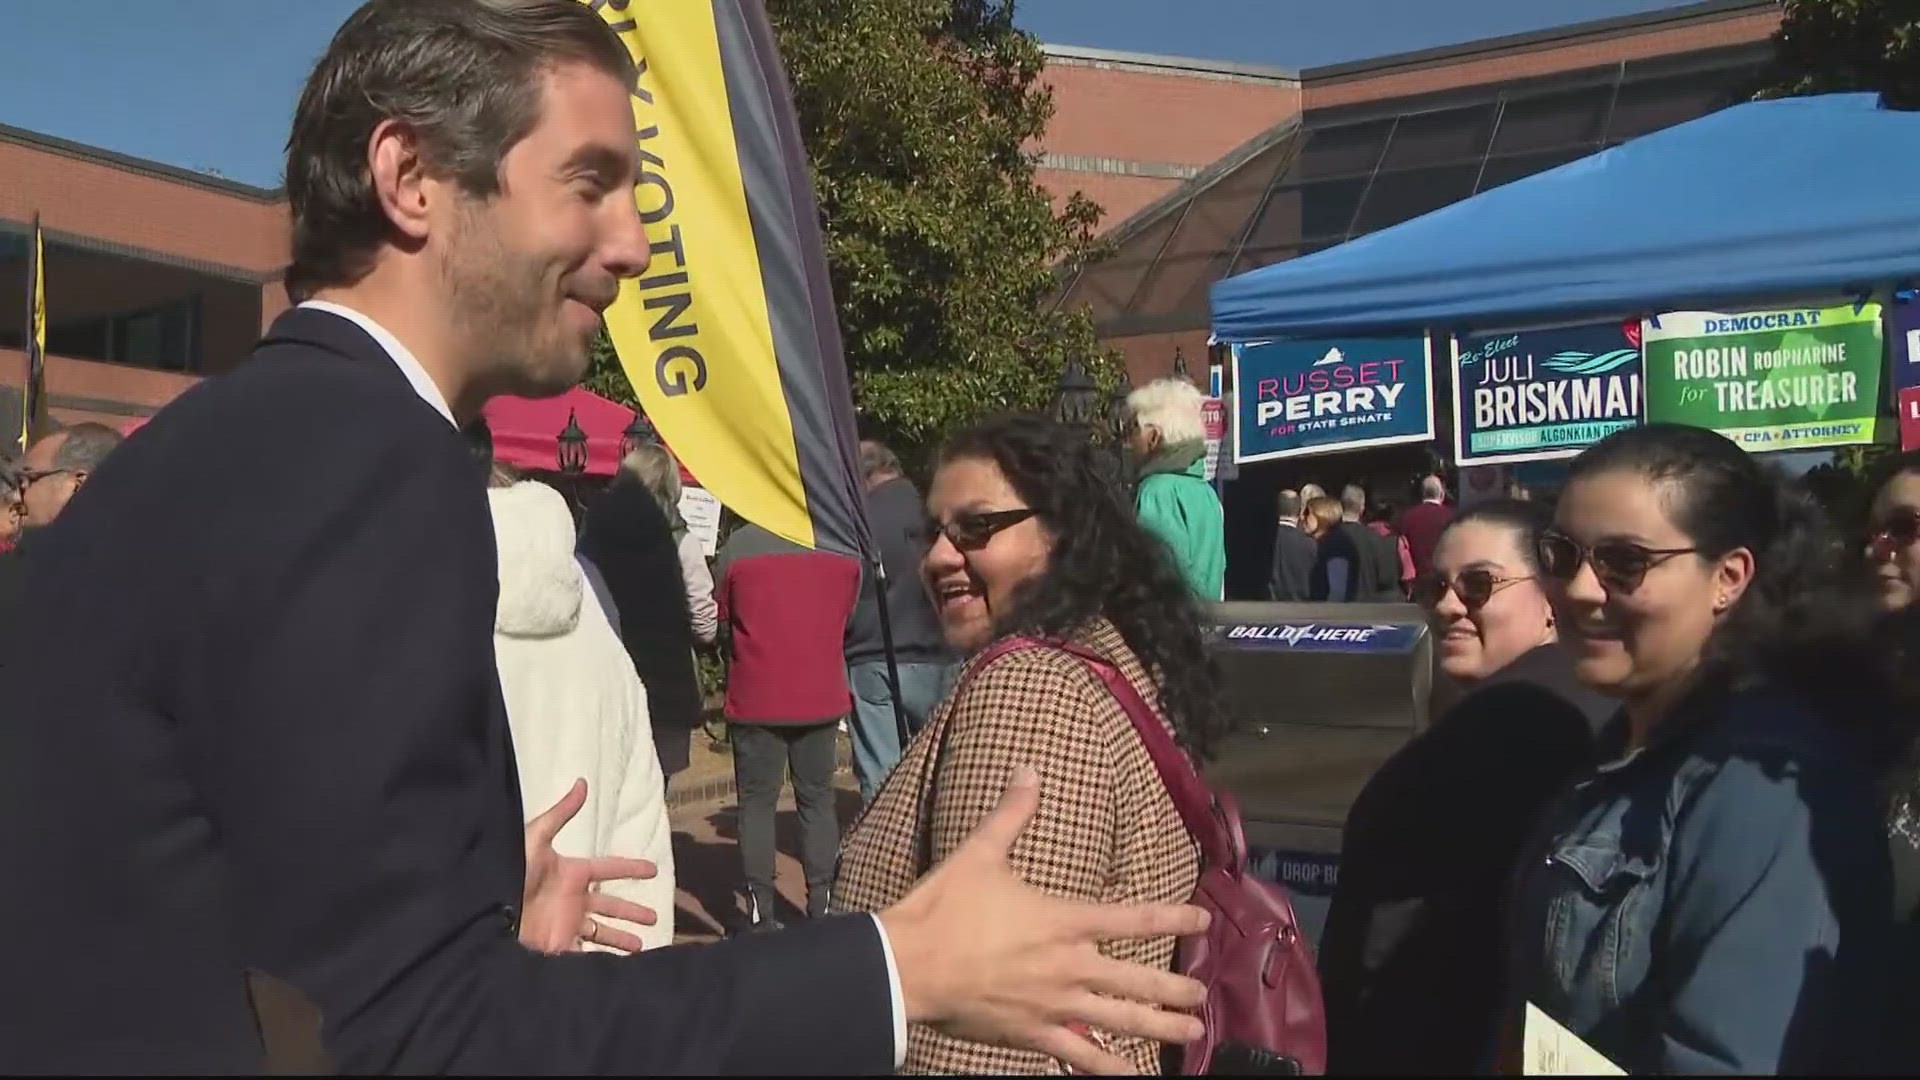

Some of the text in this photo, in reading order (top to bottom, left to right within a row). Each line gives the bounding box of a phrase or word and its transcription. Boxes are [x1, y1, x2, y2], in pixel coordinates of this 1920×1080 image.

[1704, 309, 1822, 334] DEMOCRAT
[1479, 354, 1533, 385] JULI
[1673, 342, 1847, 381] ROBIN ROOPHARINE
[1258, 359, 1405, 400] RUSSET
[1679, 370, 1858, 413] for TREASURER
[1257, 382, 1406, 427] PERRY
[1270, 412, 1393, 437] FOR STATE SENATE
[1540, 425, 1600, 443] ALGONKIAN
[1781, 423, 1861, 440] ATTORNEY
[1314, 627, 1375, 643] HERE
